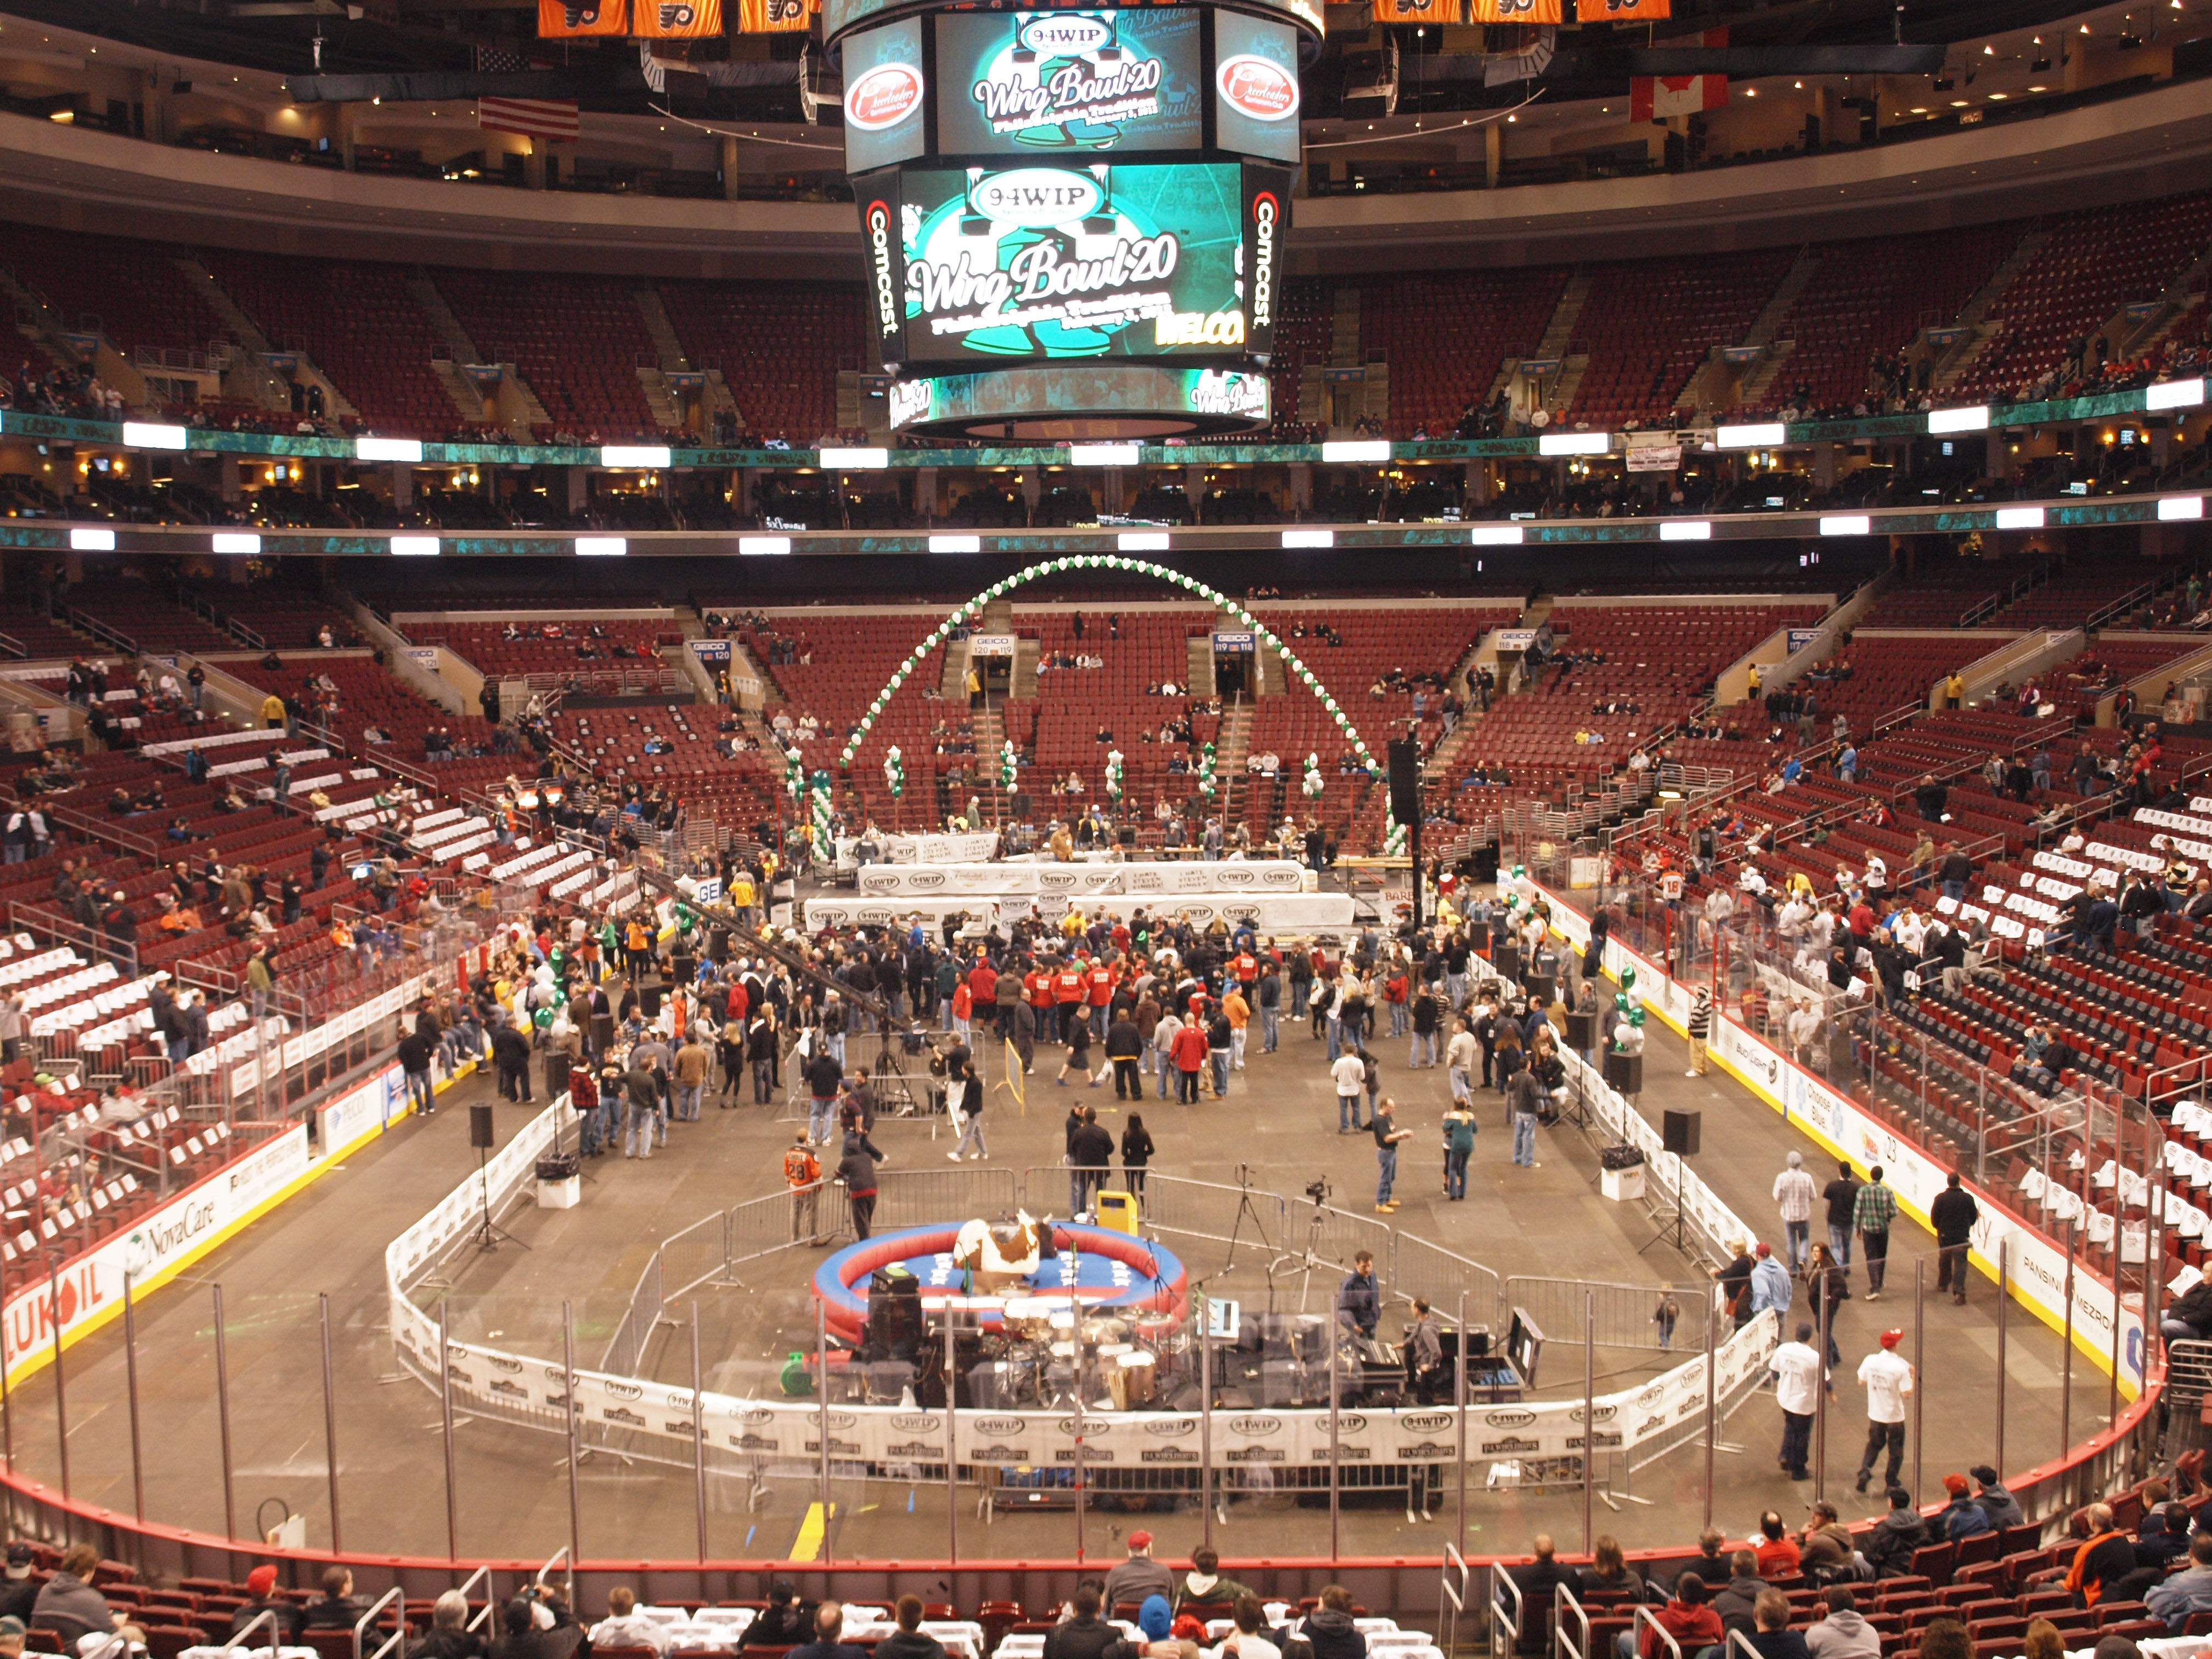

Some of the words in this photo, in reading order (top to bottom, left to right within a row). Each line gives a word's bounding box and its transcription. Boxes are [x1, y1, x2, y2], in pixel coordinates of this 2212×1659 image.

[1034, 30, 1100, 42] 94WIP
[855, 77, 913, 118] Cheerleaders
[975, 74, 1051, 121] Wing
[1050, 64, 1129, 108] Bowl
[1228, 63, 1289, 102] Cheerleaders
[994, 108, 1088, 134] Philadelphia
[1088, 97, 1158, 116] Tradition
[990, 187, 1085, 206] 94WIP
[871, 210, 898, 334] comcast
[907, 251, 1013, 320] Wing
[1012, 238, 1128, 302] Bowl
[1130, 234, 1177, 281] 20
[1254, 202, 1273, 327] comcast
[715, 651, 730, 660] 120
[1215, 642, 1227, 651] 119
[1241, 642, 1254, 651] 118
[1668, 881, 1679, 893] 18
[1808, 1083, 1831, 1114] Choose
[788, 1163, 805, 1181] 28
[148, 1201, 215, 1263] NovaCare
[2024, 1256, 2062, 1292] PANSINI
[979, 1420, 1019, 1429] 94WIP
[1235, 1419, 1275, 1429] 94WIP
[1407, 1416, 1447, 1426] 94WIP
